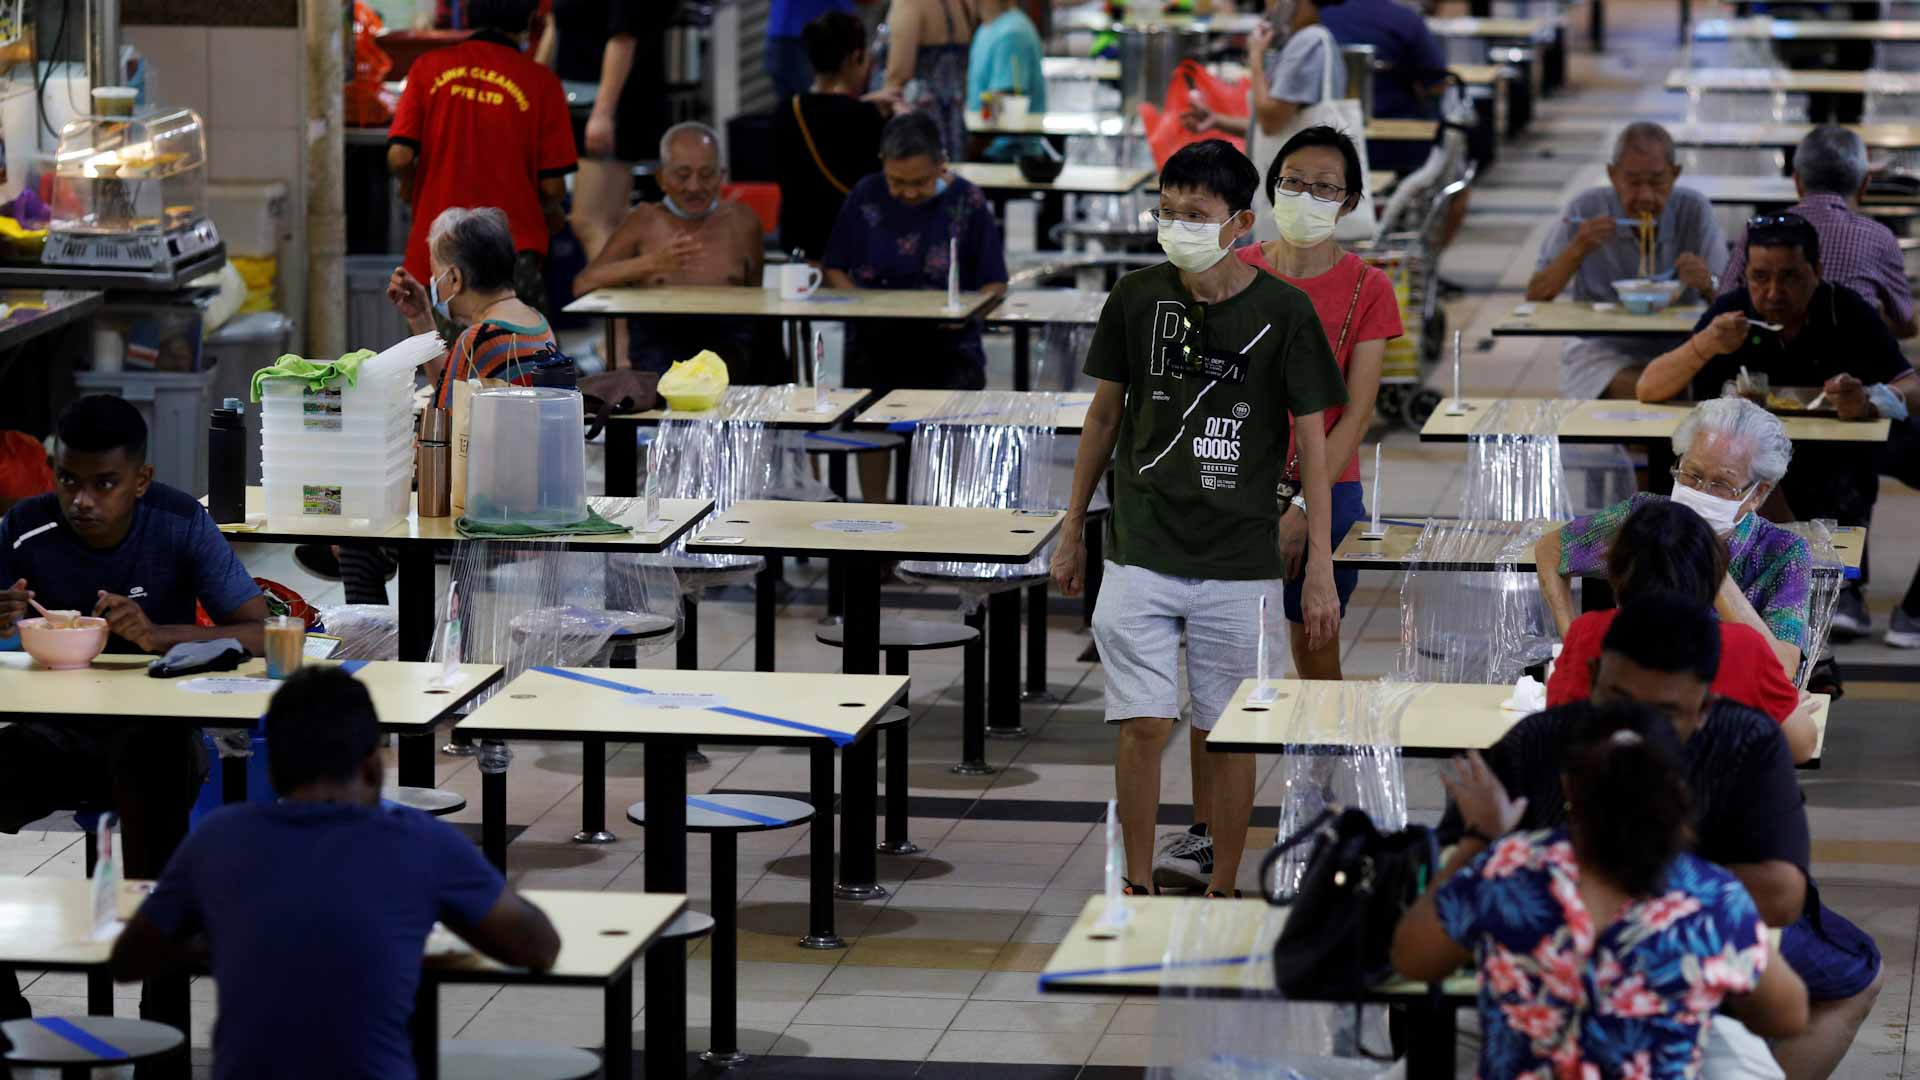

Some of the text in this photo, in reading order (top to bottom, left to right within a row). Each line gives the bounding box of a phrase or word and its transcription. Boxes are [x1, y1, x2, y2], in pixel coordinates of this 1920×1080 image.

[451, 84, 504, 105] PTE LTD
[470, 67, 529, 112] CLEANING
[1205, 417, 1243, 439] QLTY.
[1193, 437, 1240, 461] GOODS
